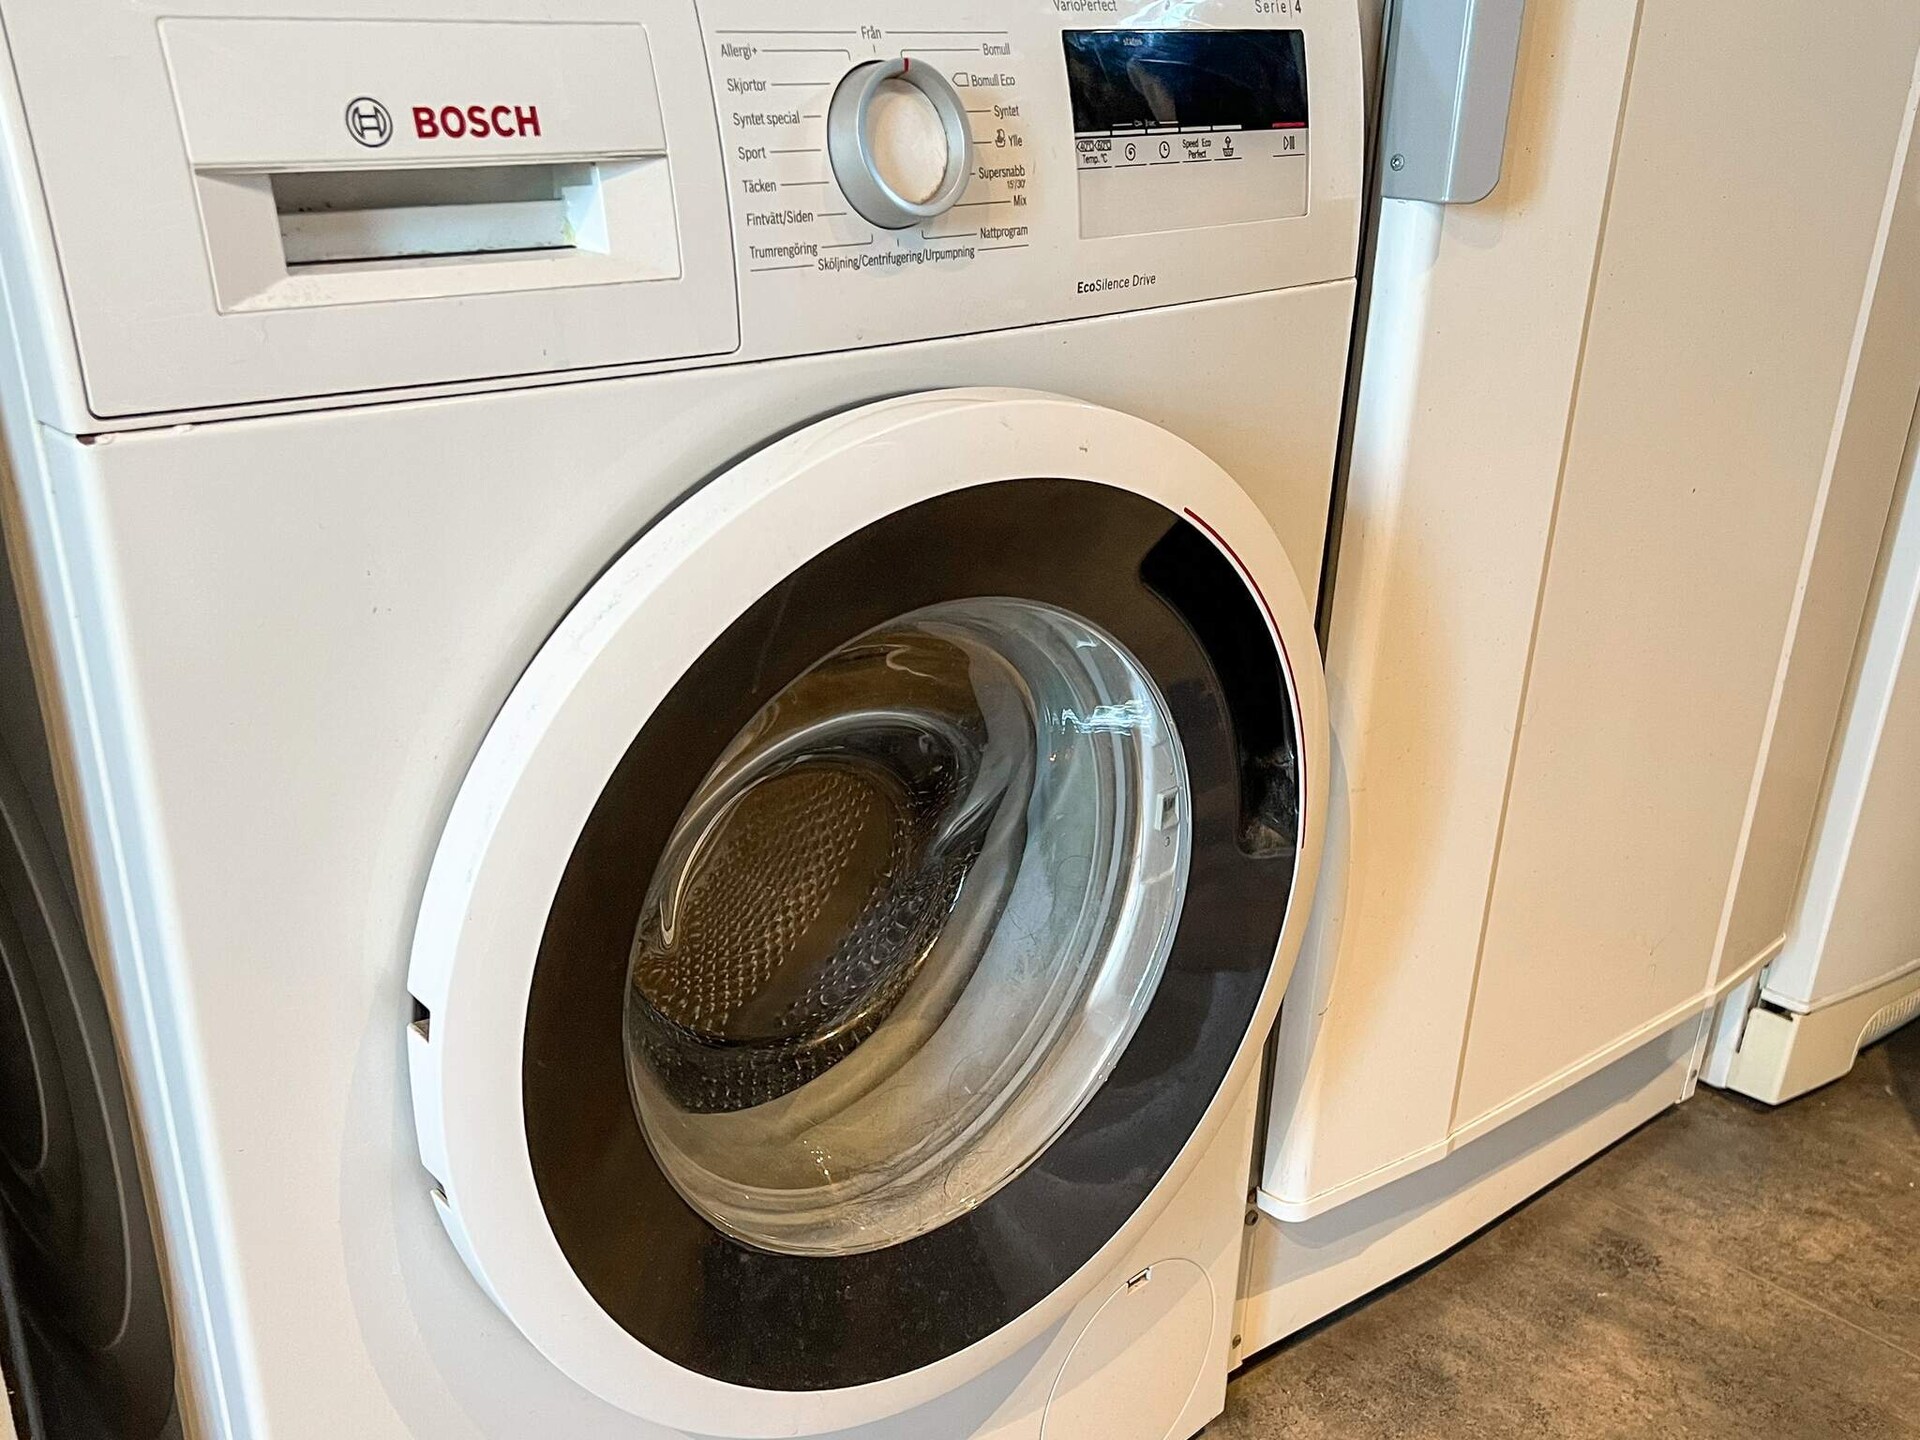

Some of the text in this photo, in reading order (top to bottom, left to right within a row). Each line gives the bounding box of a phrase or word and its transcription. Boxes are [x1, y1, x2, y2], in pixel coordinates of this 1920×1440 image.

[1053, 0, 1118, 11] VarioPerfect
[1255, 0, 1287, 13] Serie
[861, 25, 882, 40] Från
[721, 43, 758, 60] Allergi+
[982, 42, 1011, 56] Bomull
[727, 77, 767, 94] Skjortor
[972, 73, 1016, 87] Bomull Eco
[733, 110, 800, 129] Syntet special
[994, 104, 1020, 120] Syntet
[412, 105, 541, 139] BOSCH
[1008, 133, 1023, 147] Ylle
[1182, 138, 1212, 149] Speed Eco
[738, 146, 767, 162] Sport
[1188, 149, 1207, 159] Perfect
[978, 164, 1026, 181] Supersnabb
[742, 180, 777, 193] Täcken
[1013, 194, 1027, 207] Mix
[746, 210, 814, 226] Fintvätt/Siden
[980, 225, 1029, 241] Nattprogram
[749, 242, 818, 260] Trumrengöring
[817, 246, 975, 272] Sköljning/Centrifugering/Urpumpning
[1077, 273, 1156, 294] EcoSilence Drive
